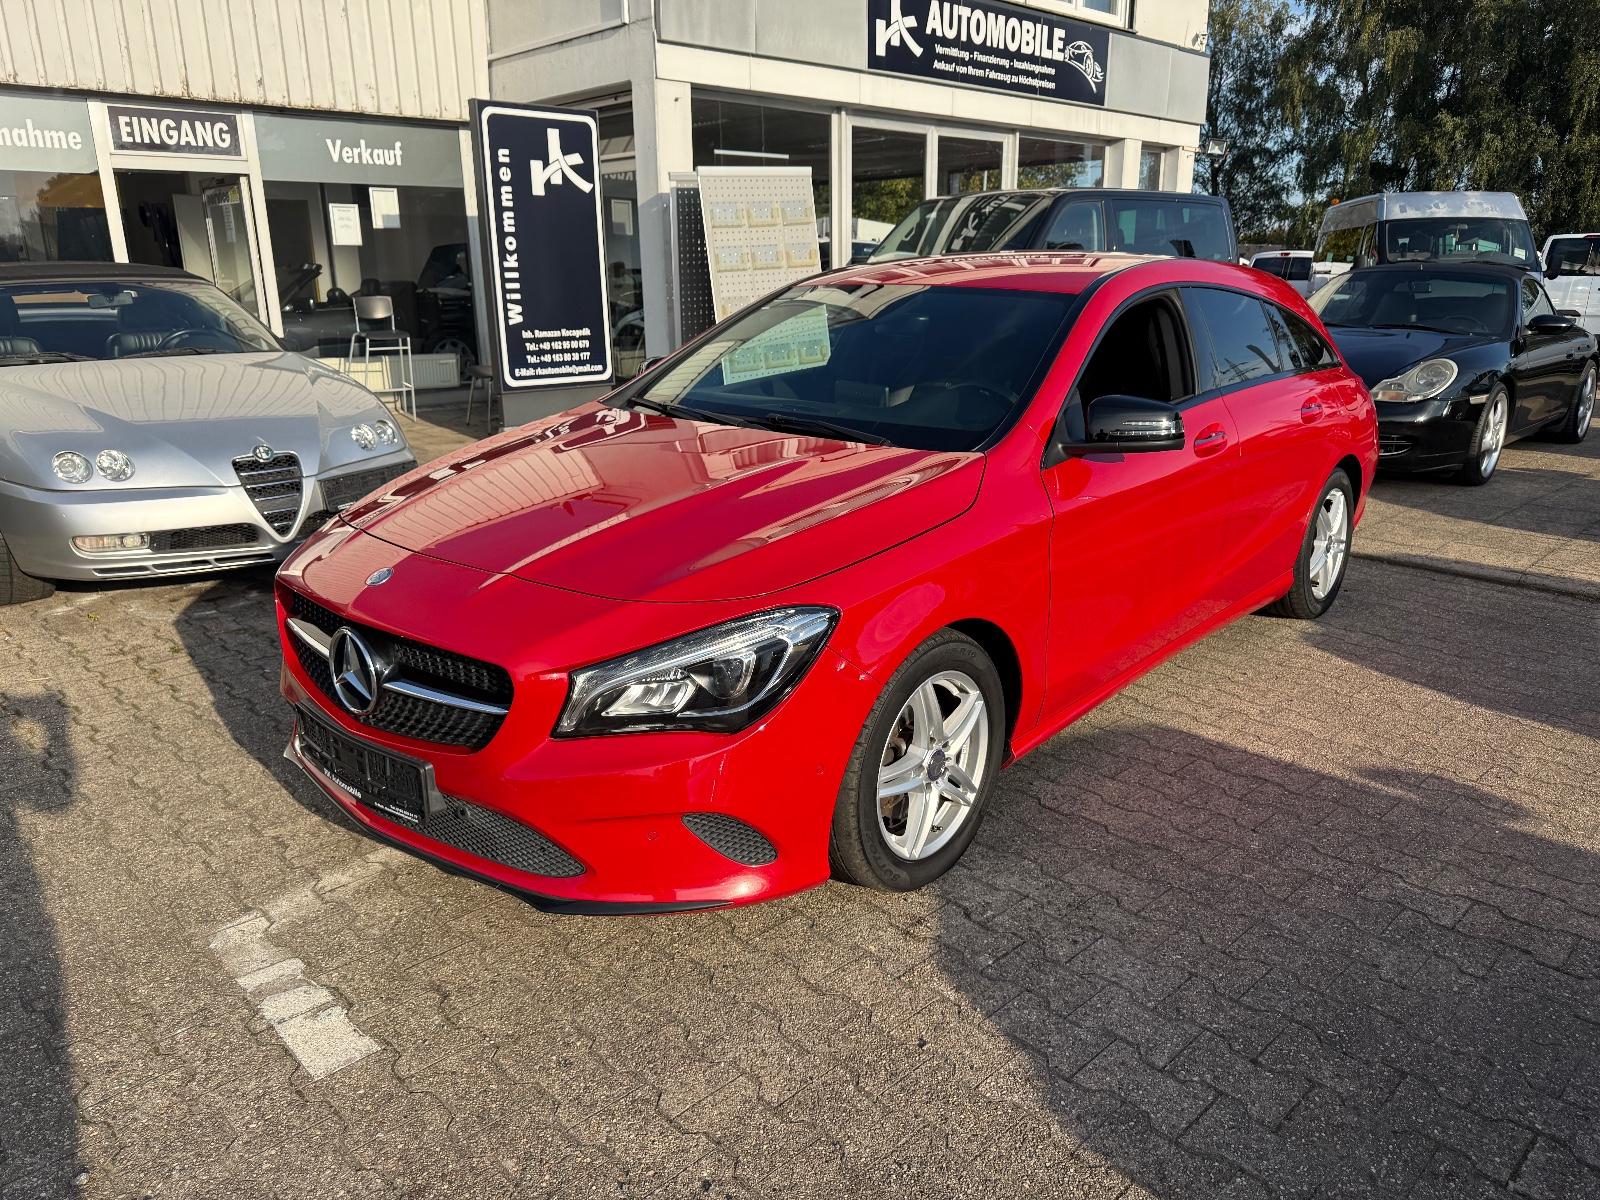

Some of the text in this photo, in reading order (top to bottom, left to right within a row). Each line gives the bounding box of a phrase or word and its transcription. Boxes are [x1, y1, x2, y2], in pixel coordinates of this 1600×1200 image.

[926, 0, 1066, 61] AUTOMOBILE
[935, 43, 969, 61] Vermittlung
[973, 51, 1010, 69] Finanzierung
[933, 59, 1056, 90] Ankauf von Ihrem Fahrzeug zu Höchstpreisen
[0, 118, 82, 150] nahme
[118, 115, 231, 148] EINGANG
[325, 138, 402, 166] Verkauf
[498, 148, 523, 326] Willkommen
[534, 329, 561, 338] Ramazan
[580, 351, 590, 361] 177
